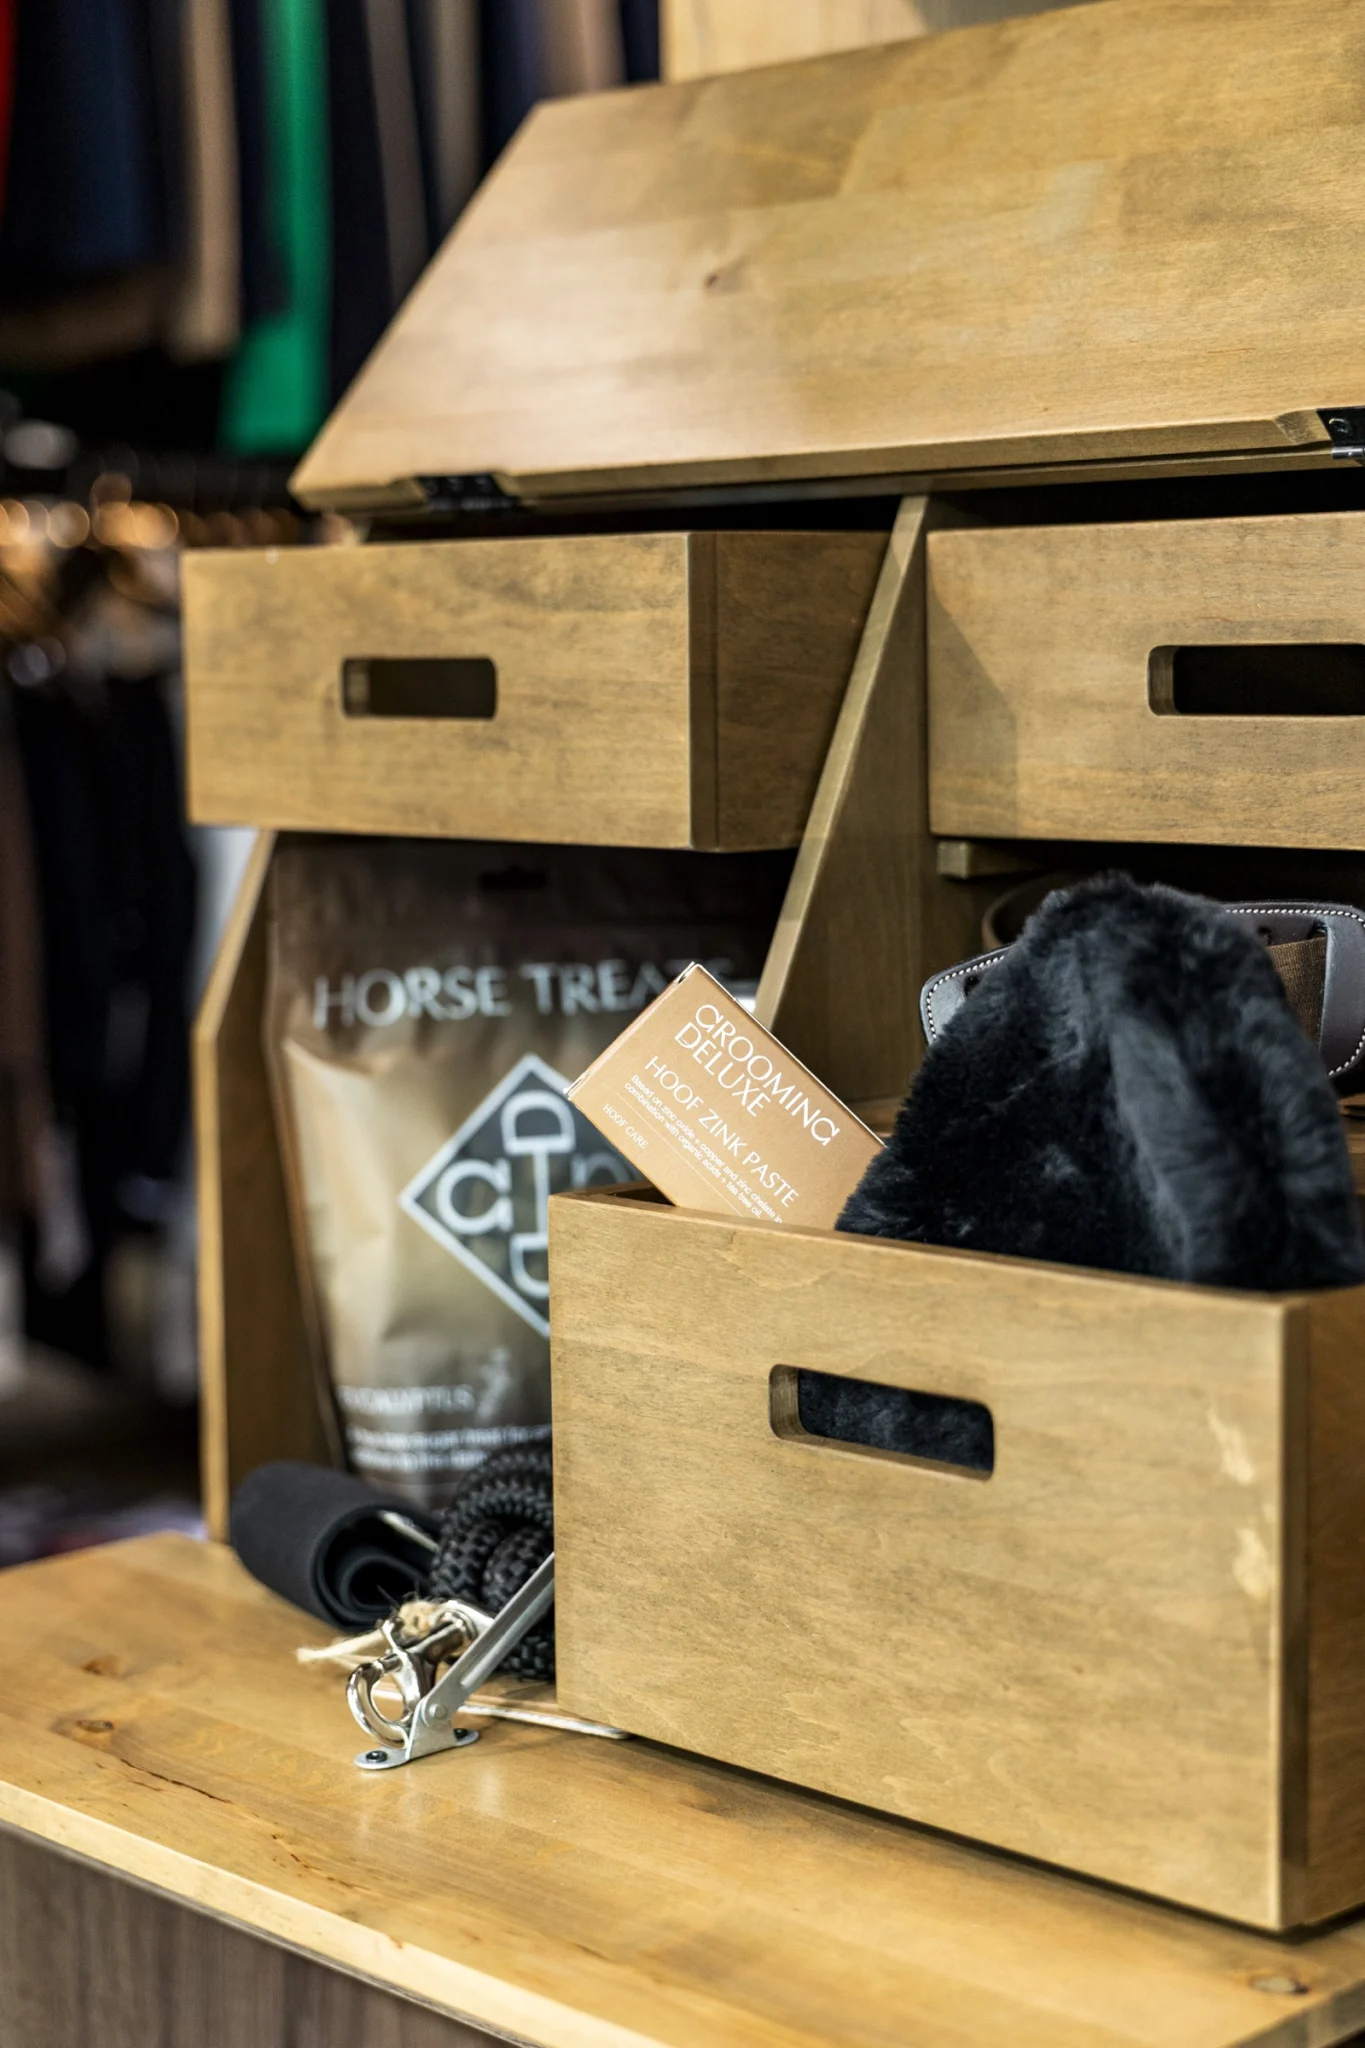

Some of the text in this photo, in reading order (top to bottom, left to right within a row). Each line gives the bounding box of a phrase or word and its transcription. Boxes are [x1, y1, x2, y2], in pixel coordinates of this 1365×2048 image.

[313, 964, 512, 1029] HORSE
[602, 1103, 649, 1150] HOOF CARE
[674, 1021, 771, 1117] DELUXE
[695, 1004, 840, 1146] GROOMING
[624, 1082, 665, 1123] combination
[664, 1121, 680, 1137] with
[678, 1135, 704, 1160] organic
[702, 1159, 721, 1178] acids
[726, 1181, 739, 1196] tea
[738, 1192, 752, 1208] tree
[631, 1074, 655, 1098] Based
[652, 1096, 663, 1107] on
[661, 1105, 676, 1121] zinc
[700, 1143, 725, 1167] copper
[723, 1166, 739, 1181] and
[737, 1179, 752, 1195] zinc
[644, 1055, 799, 1208] HOOF ZINK PASTE
